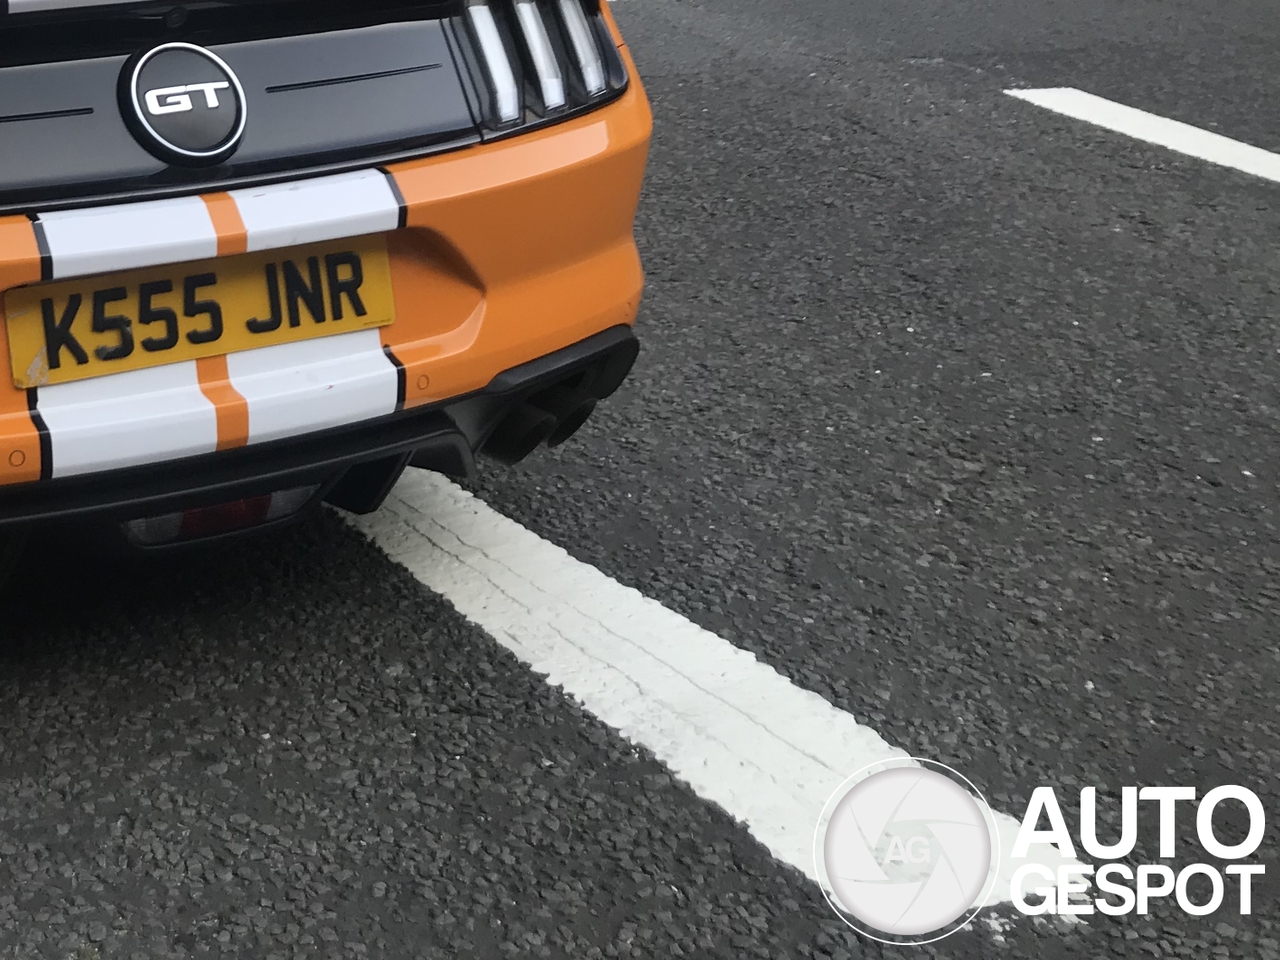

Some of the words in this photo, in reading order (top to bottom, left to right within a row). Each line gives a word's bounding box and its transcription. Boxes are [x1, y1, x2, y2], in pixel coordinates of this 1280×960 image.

[144, 80, 231, 116] GT
[40, 271, 225, 370] K555
[246, 250, 369, 336] JNR
